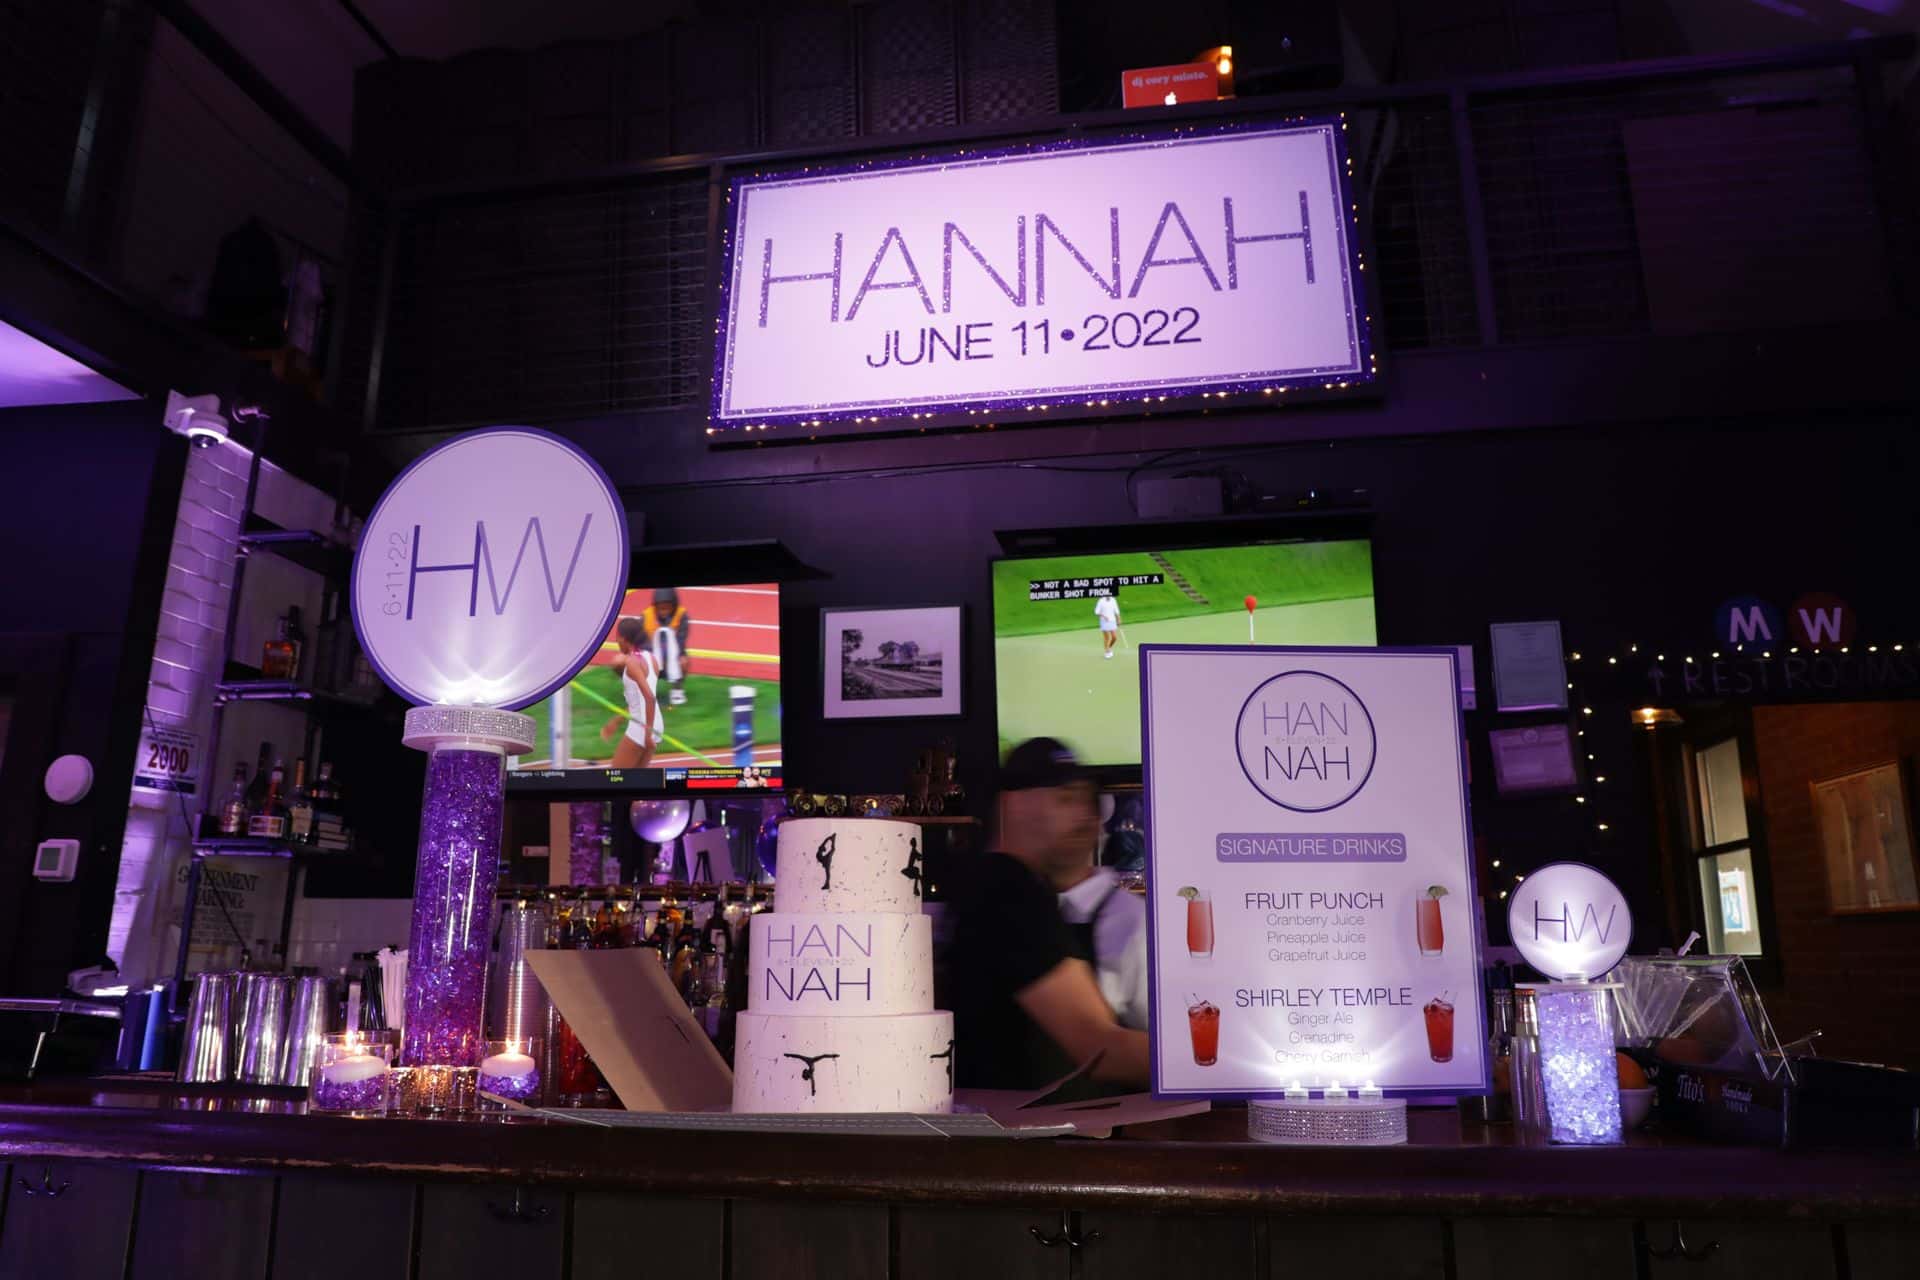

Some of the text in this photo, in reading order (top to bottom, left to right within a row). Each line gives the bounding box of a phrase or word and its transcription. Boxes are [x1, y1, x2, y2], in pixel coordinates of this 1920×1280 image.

[1131, 76, 1144, 88] dj
[758, 190, 1315, 328] HANNAH
[866, 321, 994, 368] JUNE
[406, 513, 593, 620] HW
[1043, 580, 1060, 589] NOT
[1063, 580, 1070, 588] A
[1073, 579, 1090, 588] BAD
[1093, 577, 1114, 587] SPOT
[1118, 576, 1129, 585] TO
[1132, 575, 1149, 584] HIT
[1152, 575, 1160, 583] A
[1030, 590, 1060, 600] BUNKER
[1064, 589, 1084, 599] SHOT
[1729, 606, 1842, 644] M W
[1262, 701, 1348, 736] HAN
[147, 742, 190, 773] 2000
[1264, 745, 1351, 780] NAH
[1219, 838, 1403, 856] SIGNATURE DRINKS
[1244, 892, 1384, 910] FRUIT PUNCH
[1266, 913, 1366, 929] Cranberry Juice
[1534, 900, 1617, 945] HW
[767, 924, 872, 958] HAN
[1267, 931, 1366, 946] Pineapple Juice
[1268, 948, 1367, 963] Grapefruit Juice
[766, 967, 871, 1001] NAH
[1235, 987, 1413, 1008] SHIRLEY TEMPLE
[1287, 1011, 1354, 1026] Ginger Ale
[1288, 1030, 1355, 1045] Grenadine
[1274, 1049, 1318, 1065] Cherry
